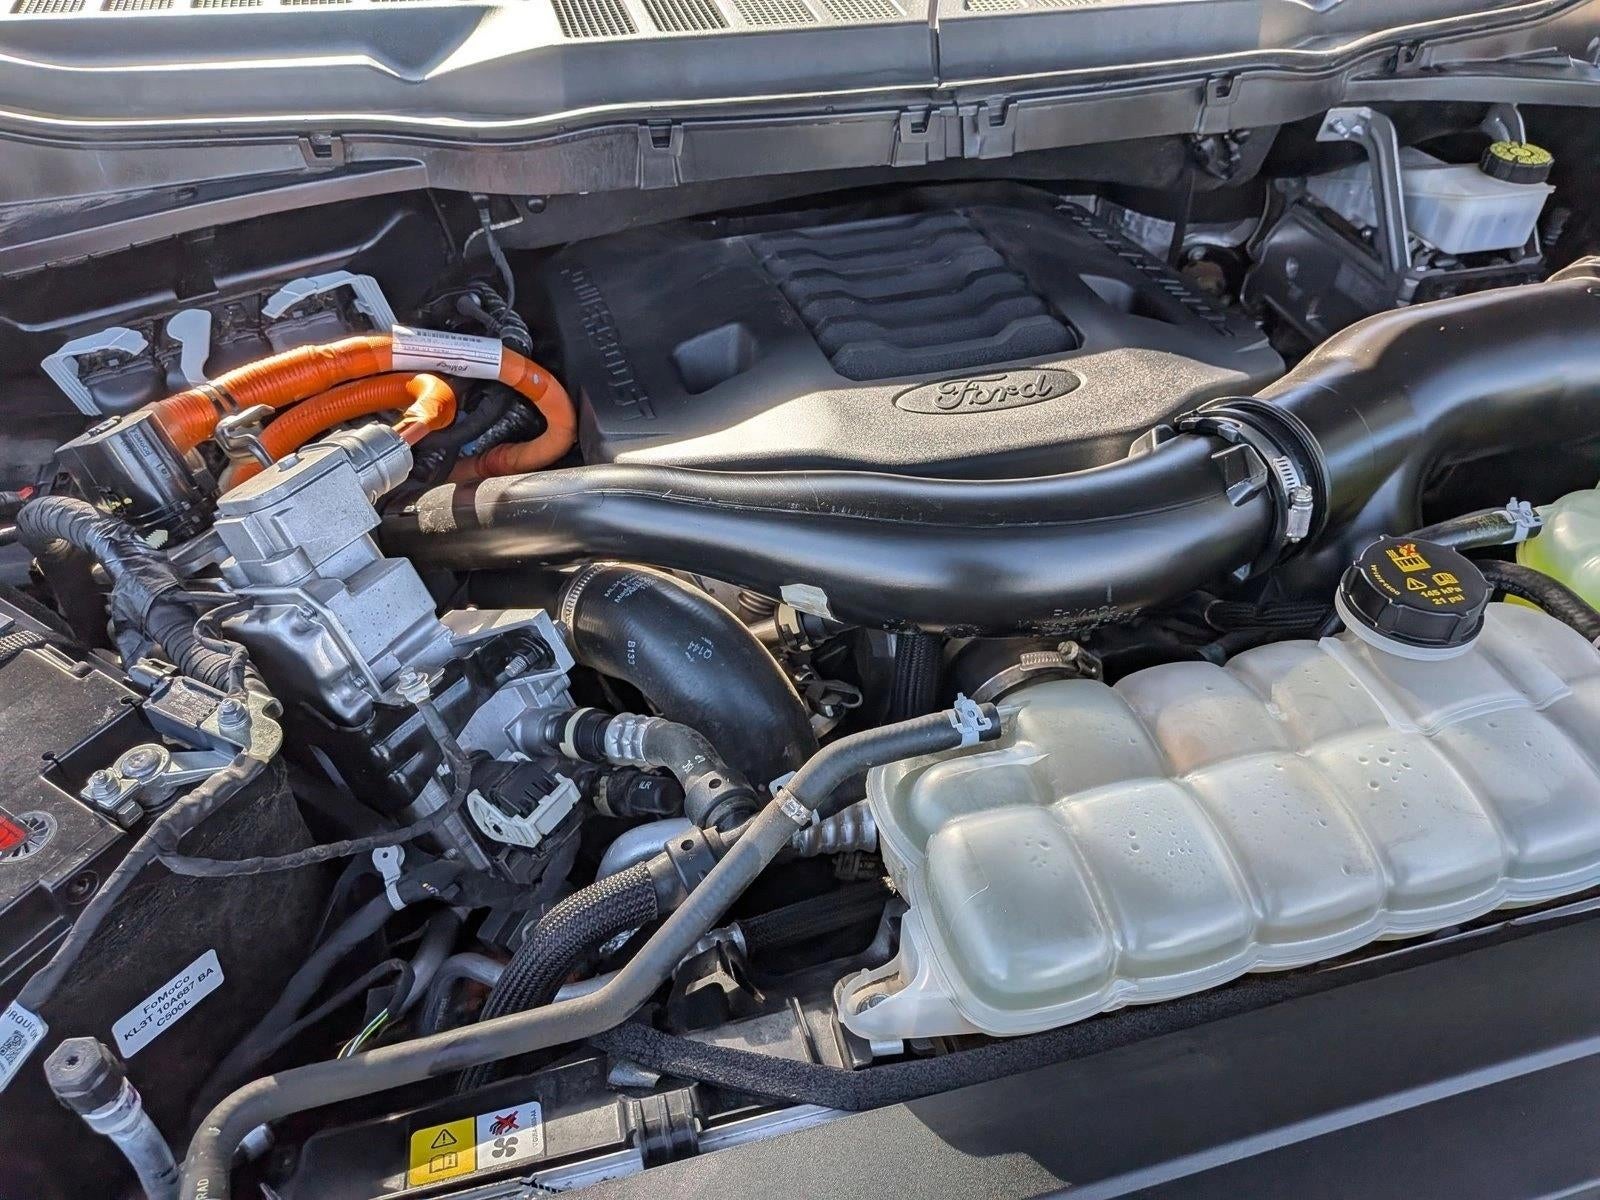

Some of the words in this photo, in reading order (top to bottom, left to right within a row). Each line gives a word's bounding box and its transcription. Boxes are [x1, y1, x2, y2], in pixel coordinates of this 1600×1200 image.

[934, 374, 1052, 410] Ford
[1421, 589, 1440, 597] 145
[1441, 587, 1462, 595] kPa
[124, 1013, 154, 1040] KL3T
[157, 981, 195, 1015] 10A687
[197, 967, 214, 982] BA
[143, 975, 190, 1014] FoMoCo
[156, 999, 192, 1027] C500L
[196, 1178, 209, 1200] RAD
